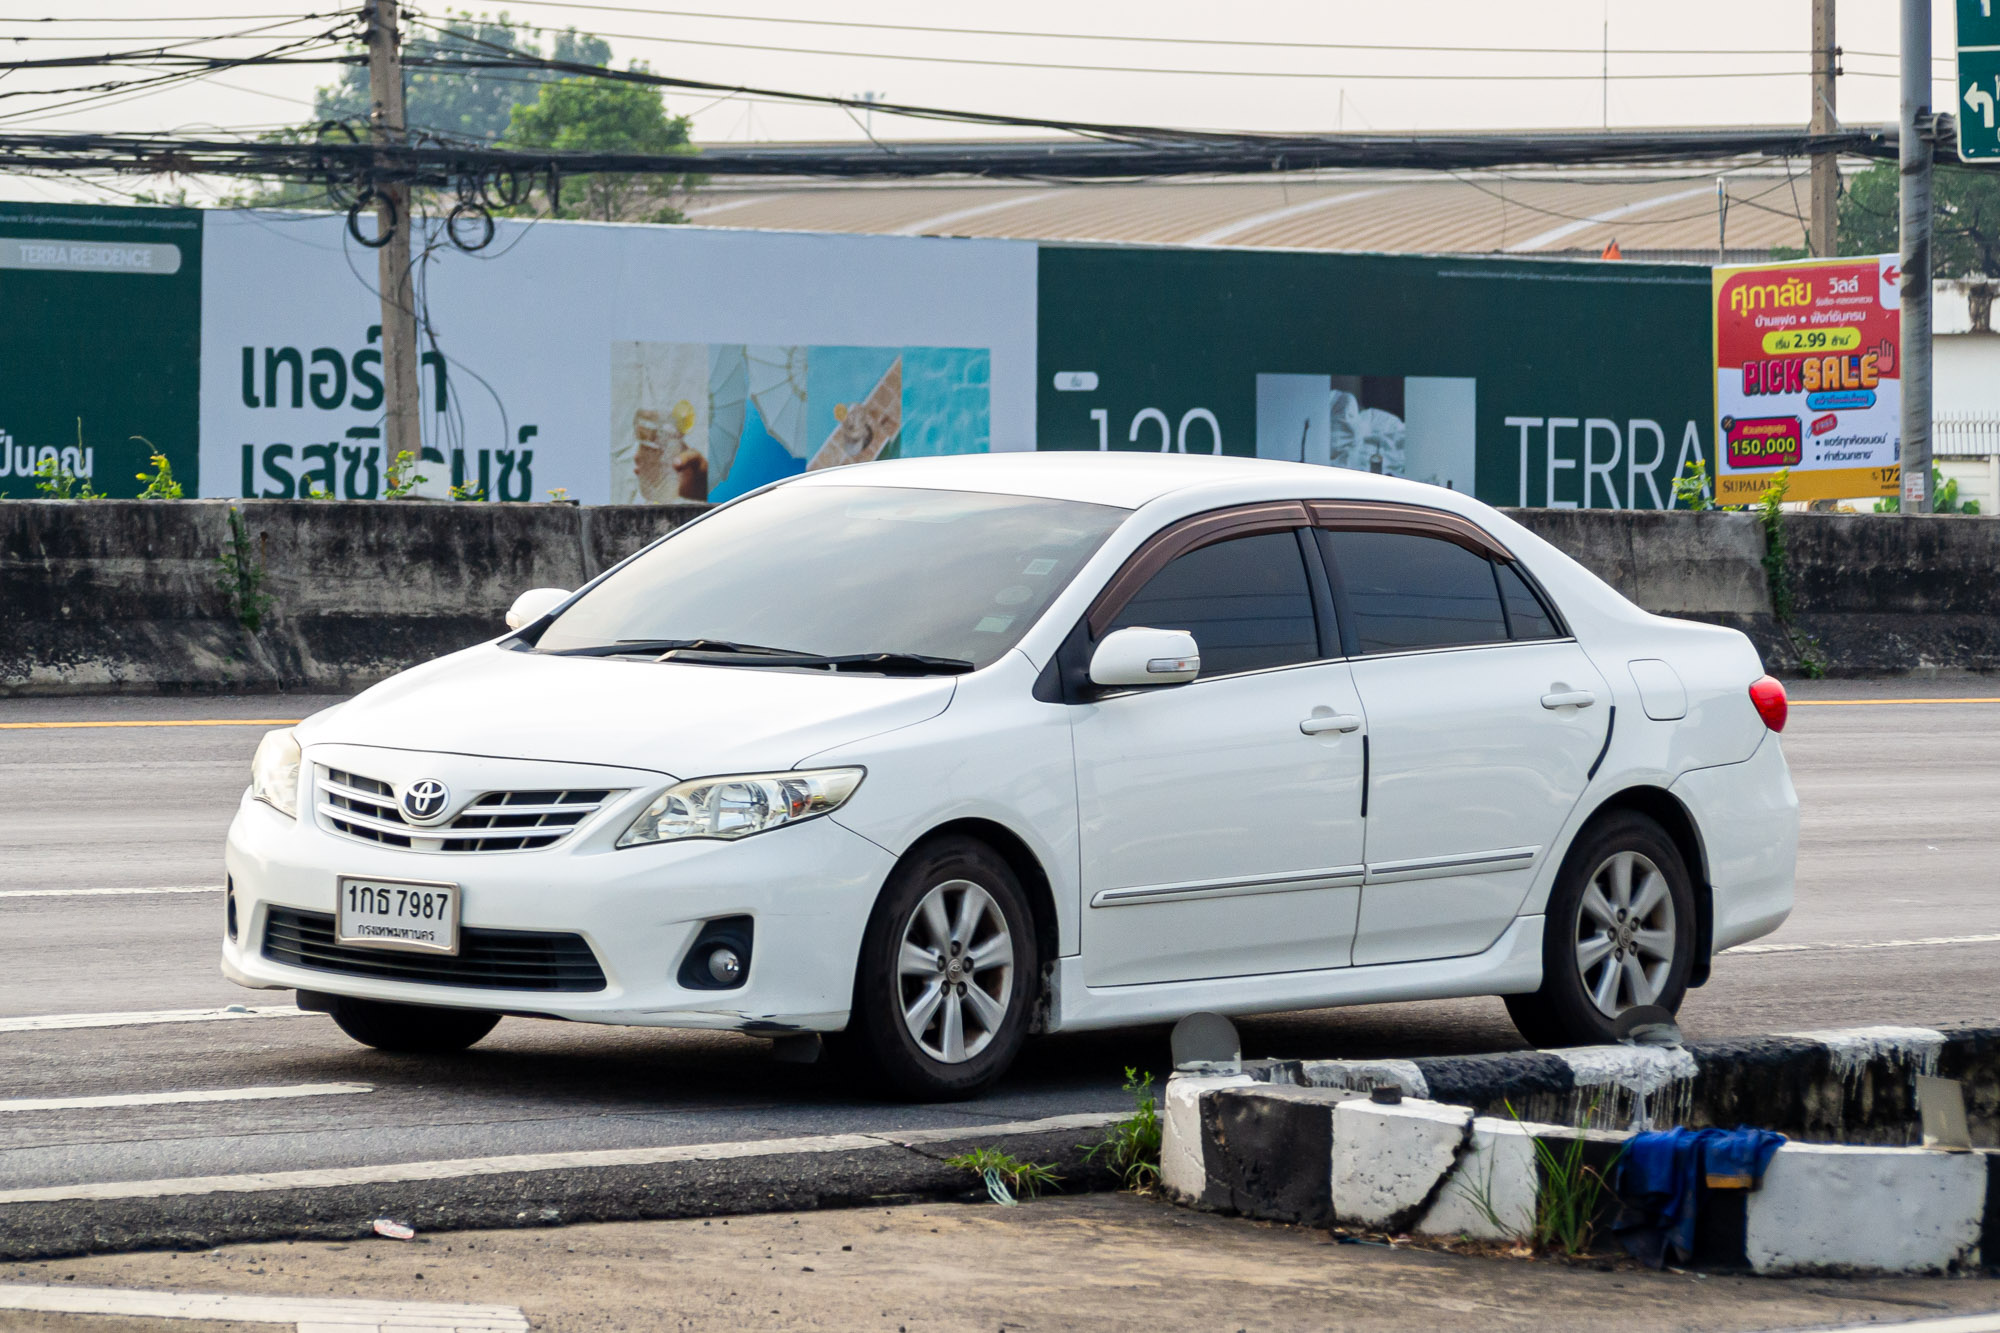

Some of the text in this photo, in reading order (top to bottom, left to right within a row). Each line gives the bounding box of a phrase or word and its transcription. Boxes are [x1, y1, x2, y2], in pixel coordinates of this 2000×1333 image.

[19, 245, 152, 267] TERRA RESIDENCE
[1731, 277, 1812, 317] ศุภาลัย
[1829, 275, 1859, 294] วิลล์
[1793, 332, 1826, 348] 2.99
[1743, 353, 1879, 396] PICK SALE
[1730, 436, 1797, 458] 150,000
[1504, 416, 1714, 511] TERRA
[349, 885, 448, 921] 1กธ 7987
[358, 924, 434, 941] กรงเทพมหานคร
